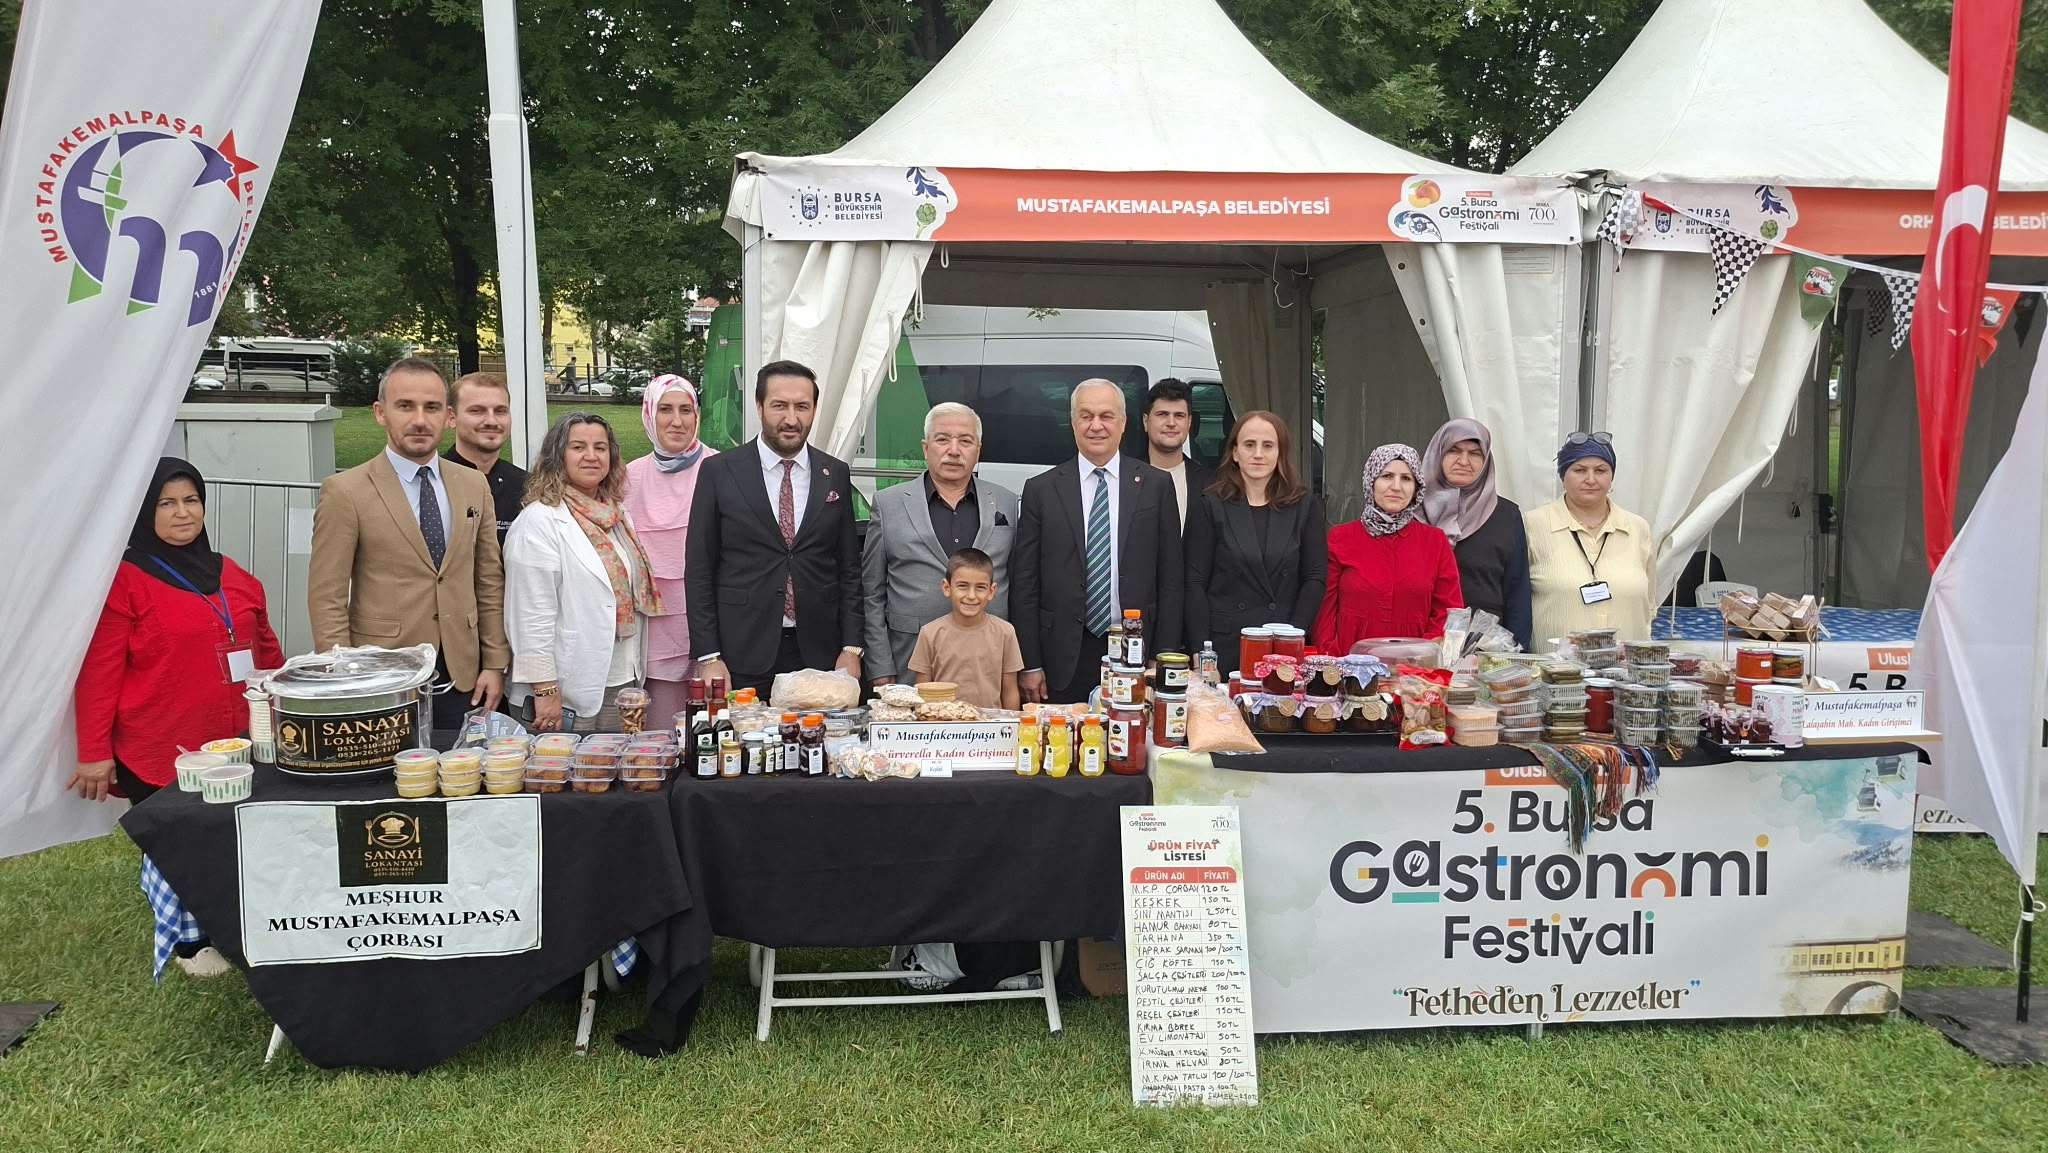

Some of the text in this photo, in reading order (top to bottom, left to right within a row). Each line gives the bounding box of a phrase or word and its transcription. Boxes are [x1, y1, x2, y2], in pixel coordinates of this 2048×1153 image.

[37, 111, 203, 262] MUSTAFAKEMALPAŞA
[835, 193, 882, 202] BURSA
[1461, 198, 1498, 206] 5. Bursa
[835, 203, 882, 211] BÜYÜKŞEHİR
[1016, 196, 1330, 216] MUSTAFAKEMALPAŞA BELEDİYESİ
[1438, 206, 1520, 220] Gastronomi
[1528, 208, 1556, 220] 700
[1460, 221, 1499, 231] Festivali
[194, 282, 218, 298] 1881
[1815, 698, 1902, 714] Mustafakemalpaşa
[323, 709, 410, 735] SANAYİ
[1838, 720, 1856, 728] Mah.
[1858, 718, 1879, 728] Kadın
[1882, 717, 1912, 729] Girişimci
[324, 728, 410, 746] LOKANTASI
[896, 728, 996, 744] Mustafakemalpaşa
[886, 748, 932, 758] ürverella
[936, 748, 964, 758] Kadın
[968, 748, 1014, 759] Girişimci
[1452, 790, 1652, 834] 5. Busa
[1211, 820, 1229, 828] 700
[1149, 839, 1218, 851] ÜRÜN FİYAT
[364, 847, 422, 860] SANAYİ
[1164, 850, 1206, 861] LİSTESİ
[1330, 834, 1769, 903] Gastronomi
[1144, 870, 1168, 880] ÜRÜN
[1204, 870, 1229, 880] FİYATI
[1201, 885, 1218, 894] 120
[345, 890, 444, 907] MEŞHUR
[267, 909, 520, 932] MUSTAFAKEMALPAŞA
[1134, 921, 1169, 932] HAMUR
[1136, 934, 1184, 944] TARHANA
[1208, 933, 1221, 942] 350
[1444, 910, 1654, 964] Festivali
[347, 934, 443, 952] ÇORBASI
[1135, 946, 1172, 956] YAPRAK
[1162, 959, 1194, 968] KÖFTE
[1136, 970, 1168, 981] SALÇA
[1136, 997, 1165, 1007] PESTİL
[1136, 1010, 1162, 1020] REÇEL
[1137, 1022, 1162, 1032] KIRMA
[1140, 1034, 1154, 1044] EV
